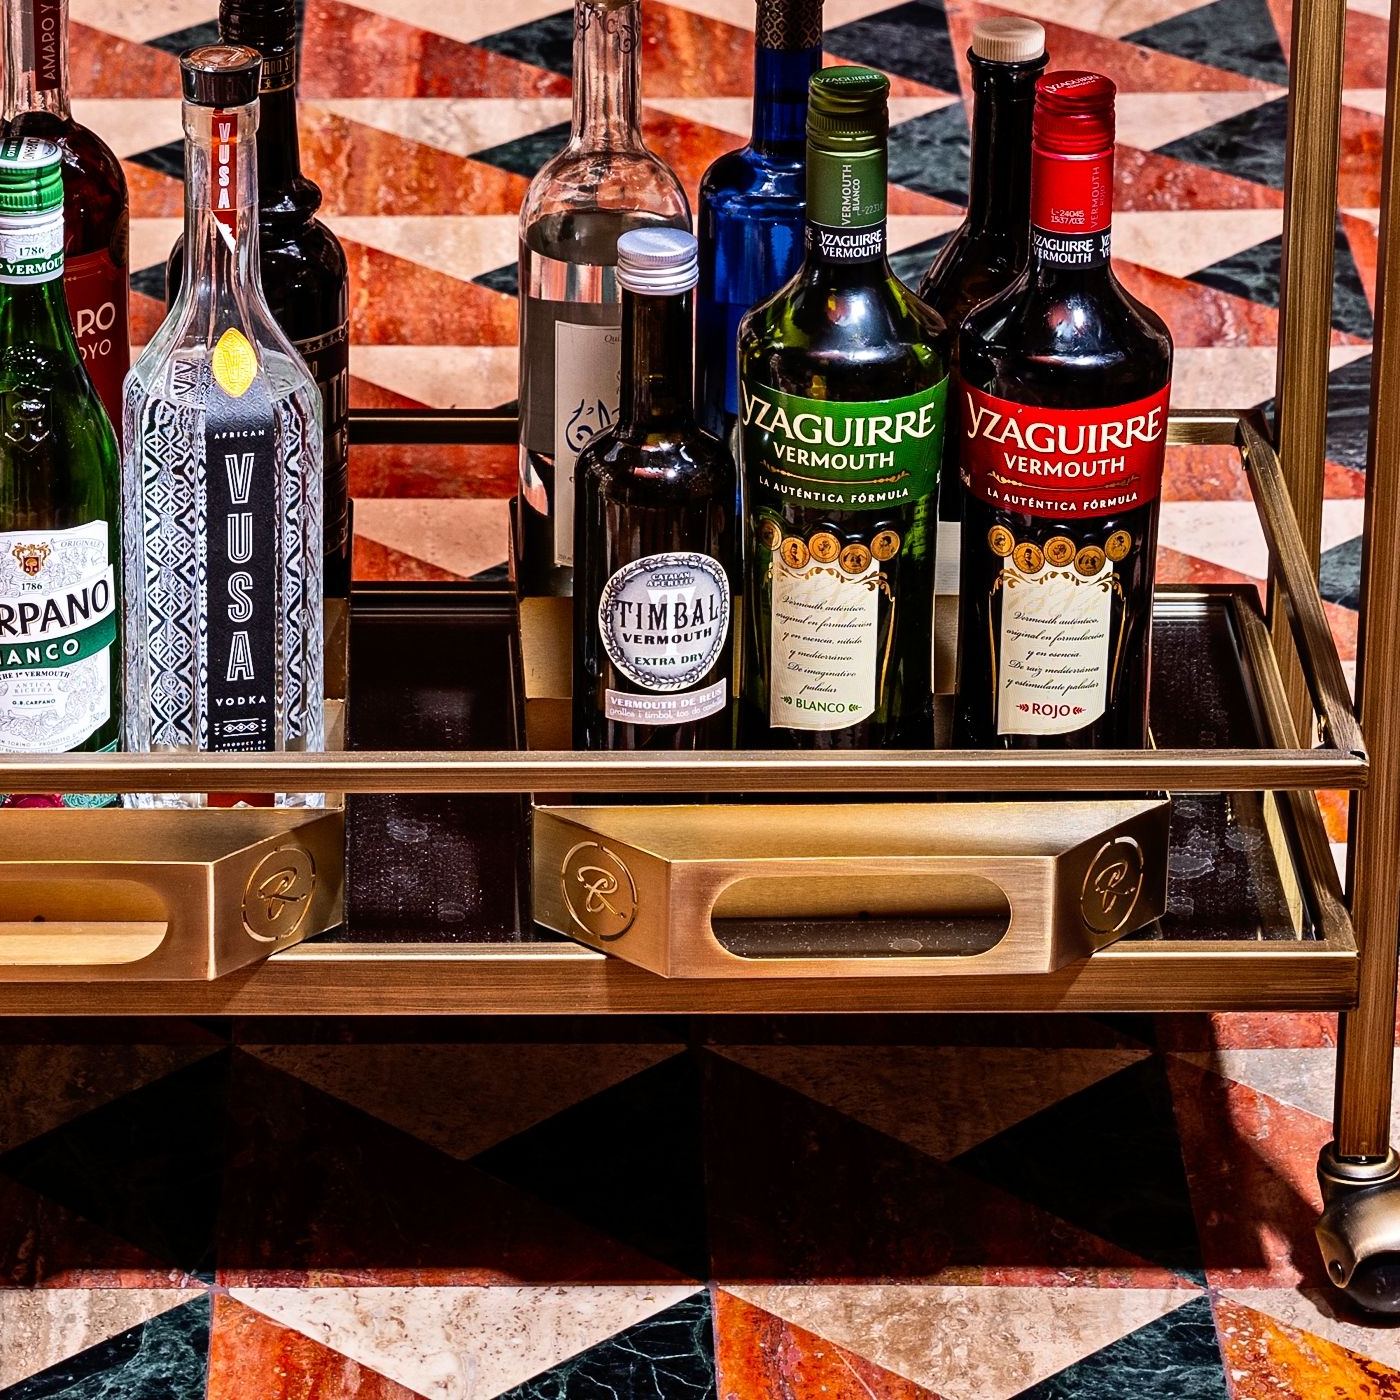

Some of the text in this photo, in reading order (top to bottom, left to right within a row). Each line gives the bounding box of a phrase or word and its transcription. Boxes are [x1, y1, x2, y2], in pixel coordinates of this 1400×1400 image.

[41, 5, 54, 15] Y
[42, 17, 56, 81] AMARO
[218, 122, 231, 209] VUSA
[841, 164, 852, 226] VERMOUTH
[852, 178, 861, 212] BLANCO
[1090, 166, 1100, 229] VERMOUTH
[819, 229, 883, 248] YZAGUIRRE
[1032, 231, 1094, 252] YZAGUIRRE
[19, 246, 45, 256] 1786
[822, 243, 881, 258] VERMOUTH
[1033, 246, 1092, 264] VERMOUTH
[6, 254, 64, 275] VERMOUT
[604, 334, 621, 344] Qui
[741, 379, 936, 447] YZAGUIRRE
[966, 391, 1162, 455] YZAGUIRRE
[214, 429, 266, 440] AFRICAN
[773, 441, 895, 470] VERMOUTH
[1003, 452, 1125, 478] VERMOUTH
[759, 475, 909, 504] LA AUTÉNTICA FÓRMULA
[987, 487, 1138, 511] LA AUTÉNTICA FÓRMULA
[60, 540, 102, 549] ORIGINALE
[225, 452, 255, 682] VUSA
[651, 571, 690, 581] CATALAN
[21, 582, 43, 591] 1786
[647, 577, 695, 588] APERITIF
[613, 593, 719, 631] TIMBAL
[782, 595, 823, 611] Vermouth
[775, 611, 810, 626] original
[816, 617, 873, 633] formulación
[1012, 611, 1059, 625] Vermouth
[622, 627, 712, 645] VERMOUTH
[1006, 627, 1044, 641] original
[1049, 629, 1105, 647] formulación
[634, 652, 704, 666] EXTRA DRY
[1008, 659, 1024, 670] De
[1025, 650, 1033, 661] y
[25, 671, 71, 679] VERMOUTH
[786, 661, 803, 673] De
[799, 682, 837, 695] paladar
[1005, 678, 1100, 697] y estimulante paladar
[215, 695, 267, 707] VODKA
[610, 687, 723, 709] VERMOUTH DE REUS
[796, 698, 846, 713] BLANCO
[1031, 702, 1071, 719] ROJO
[222, 740, 254, 748] PRODUCT
